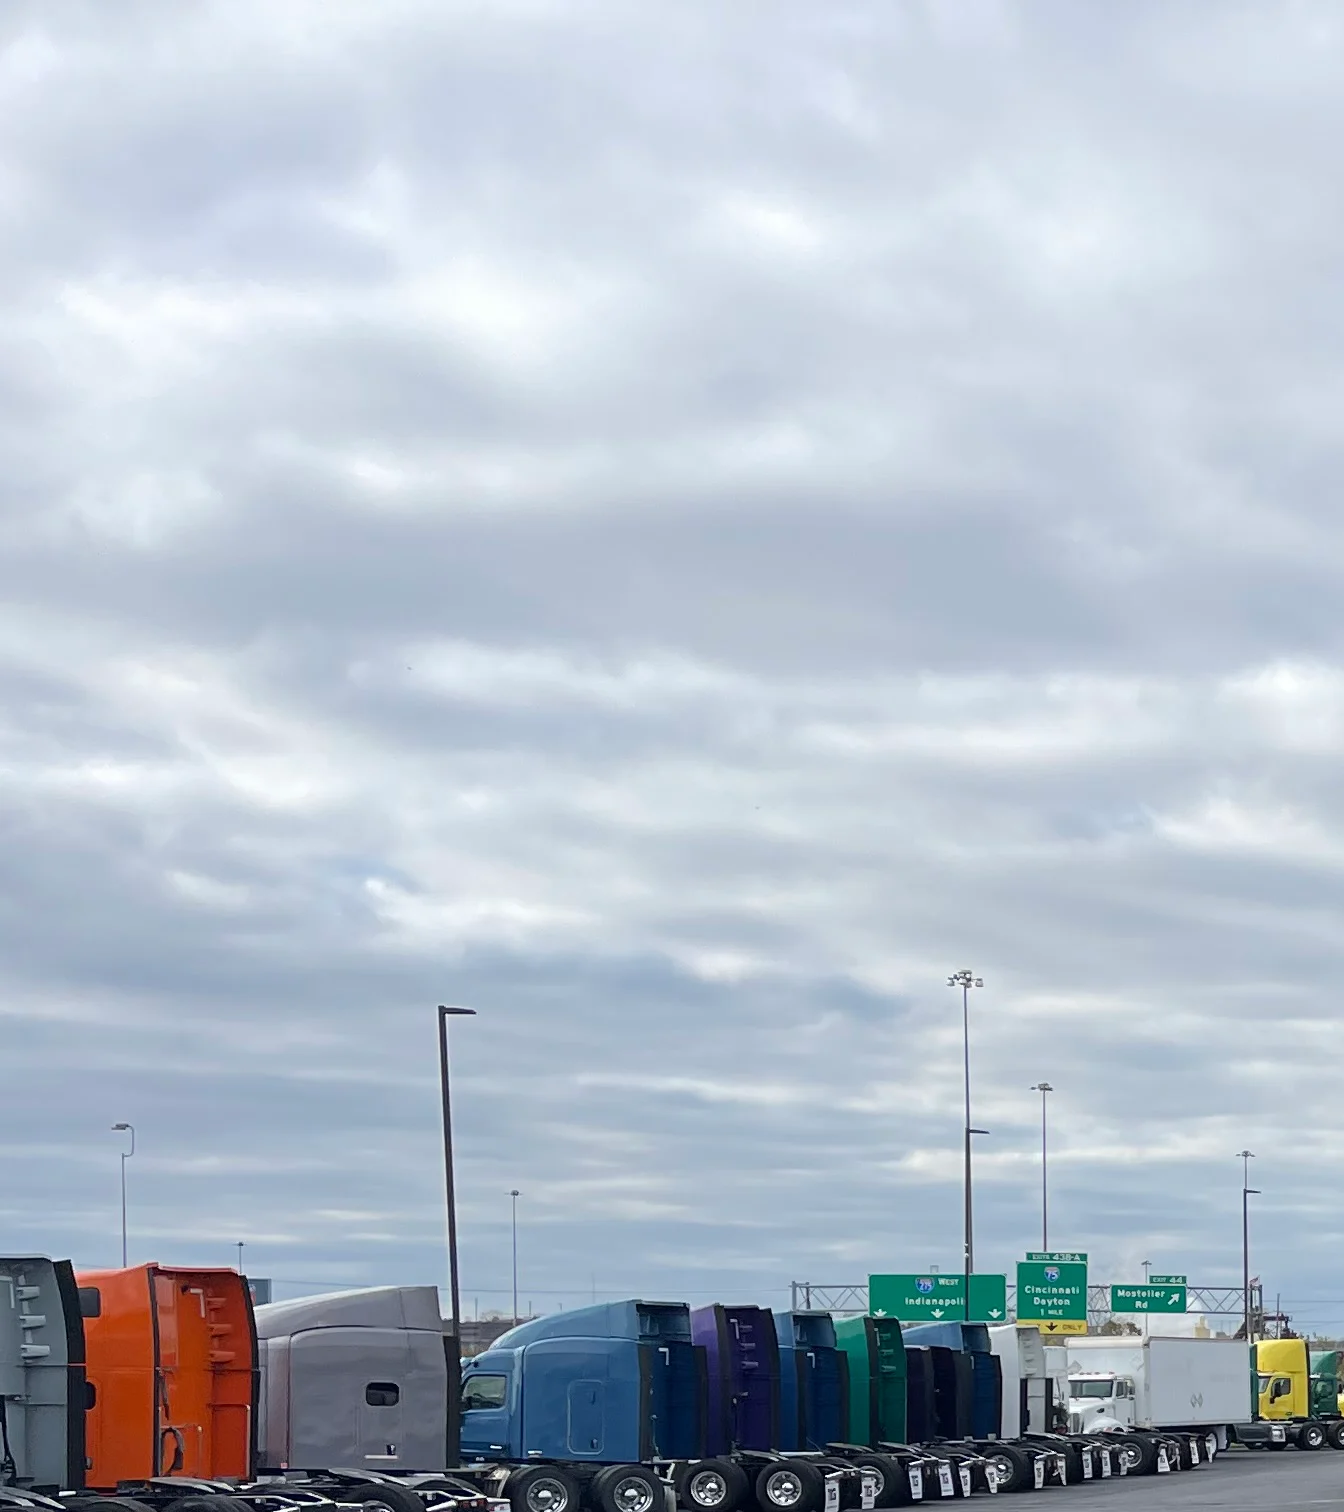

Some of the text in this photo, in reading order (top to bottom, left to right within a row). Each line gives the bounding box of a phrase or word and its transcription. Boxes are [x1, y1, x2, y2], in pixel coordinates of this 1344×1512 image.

[1046, 1271, 1058, 1280] 75
[1024, 1285, 1080, 1294] Cincinnati
[1117, 1289, 1166, 1298] Mosteller
[905, 1297, 966, 1306] Indianapoli
[1033, 1297, 1070, 1306] Dayton
[1135, 1301, 1148, 1309] Rd
